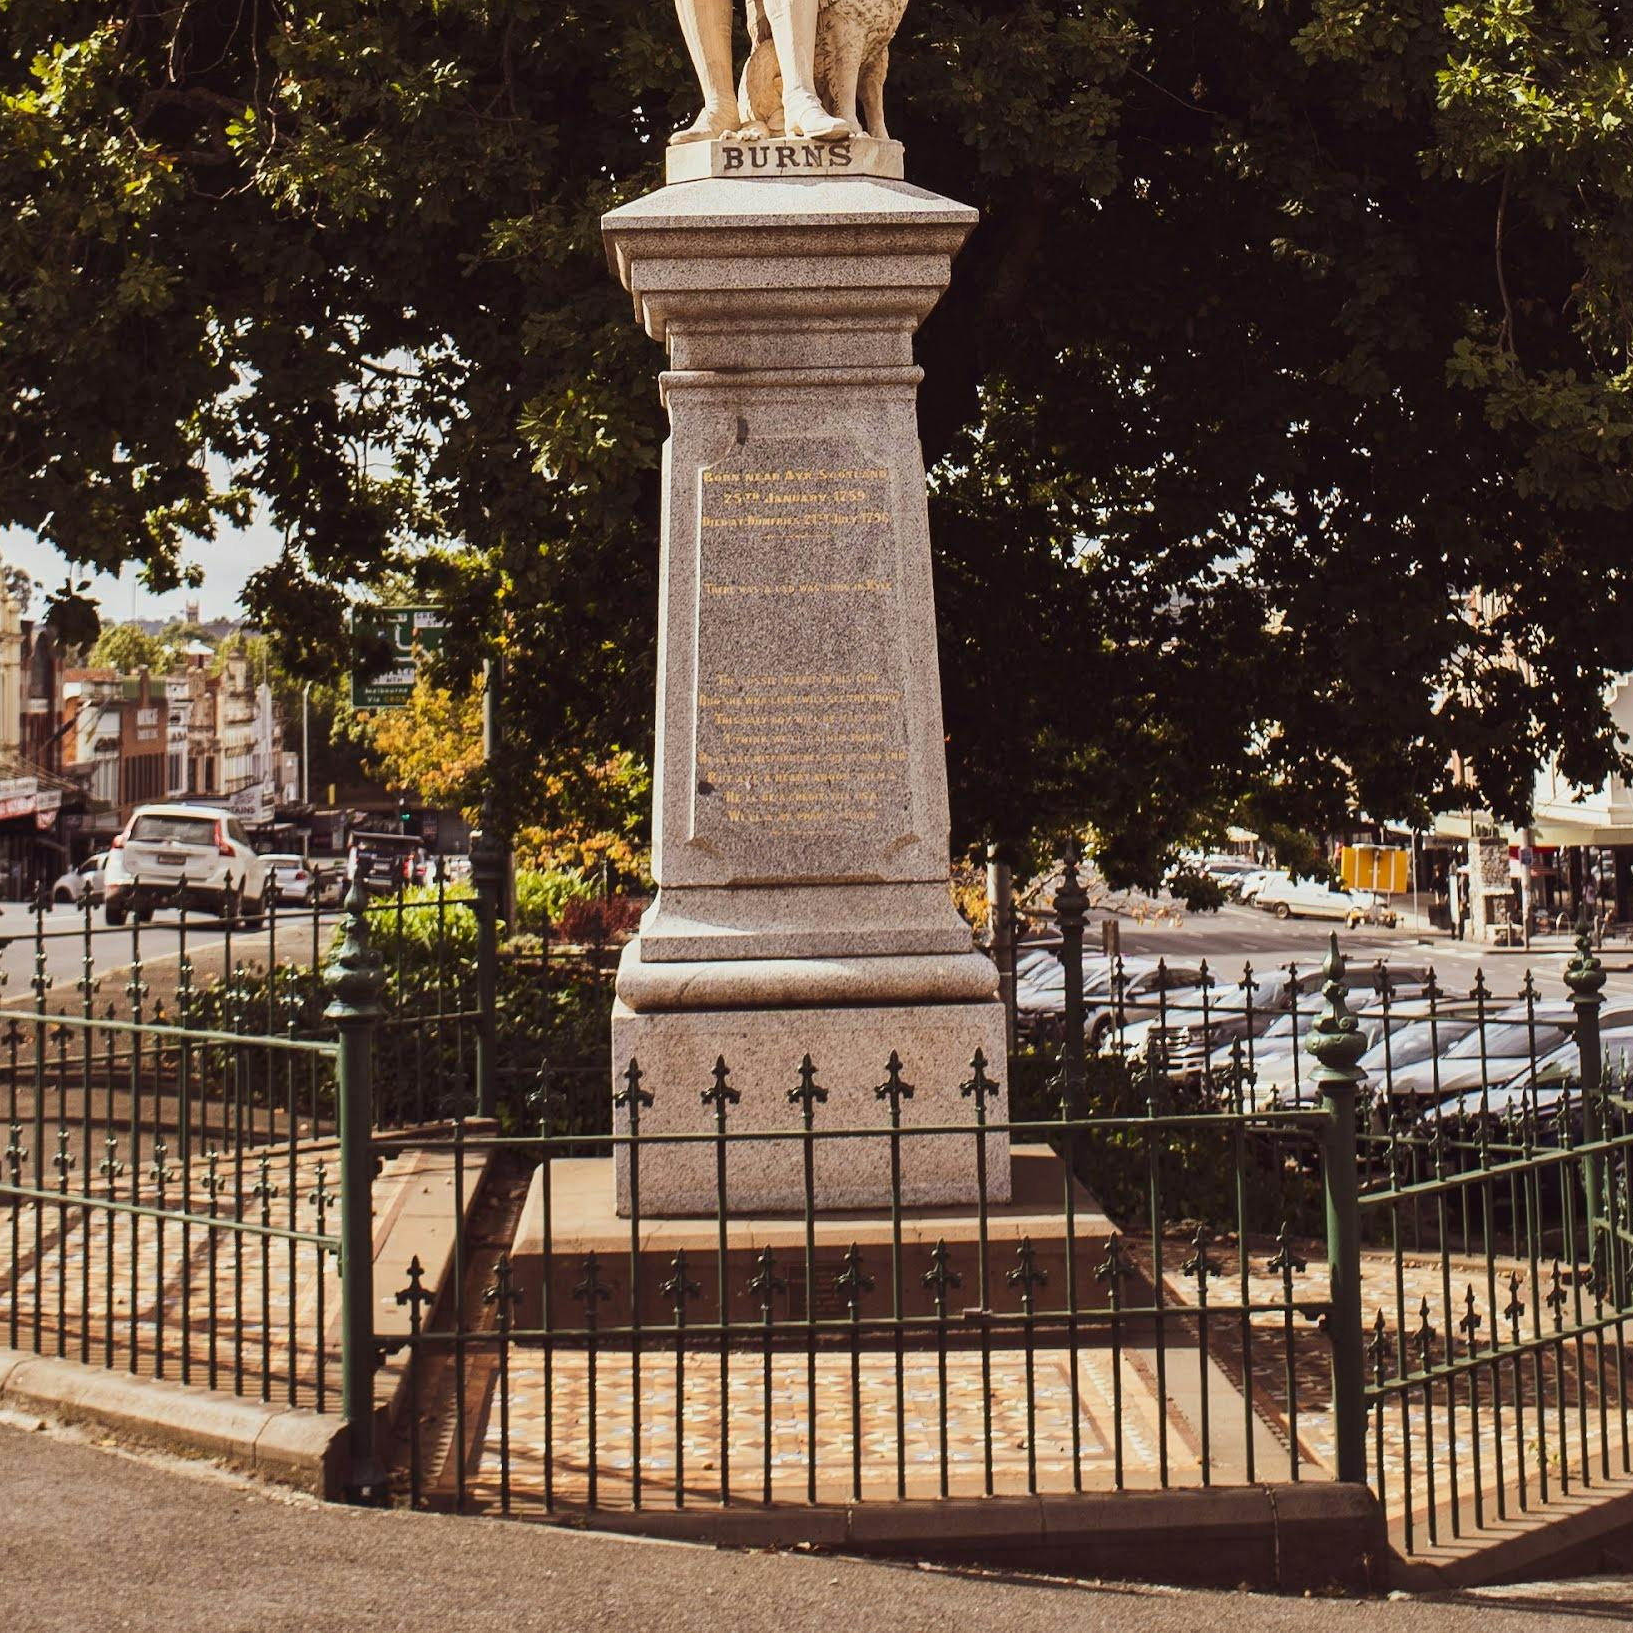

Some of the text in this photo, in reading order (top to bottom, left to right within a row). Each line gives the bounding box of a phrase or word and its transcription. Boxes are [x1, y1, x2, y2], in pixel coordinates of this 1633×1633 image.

[722, 143, 853, 170] BURNS
[703, 468, 889, 483] BORN NEAR AYR SCOTLAND
[764, 492, 826, 503] JANUARY
